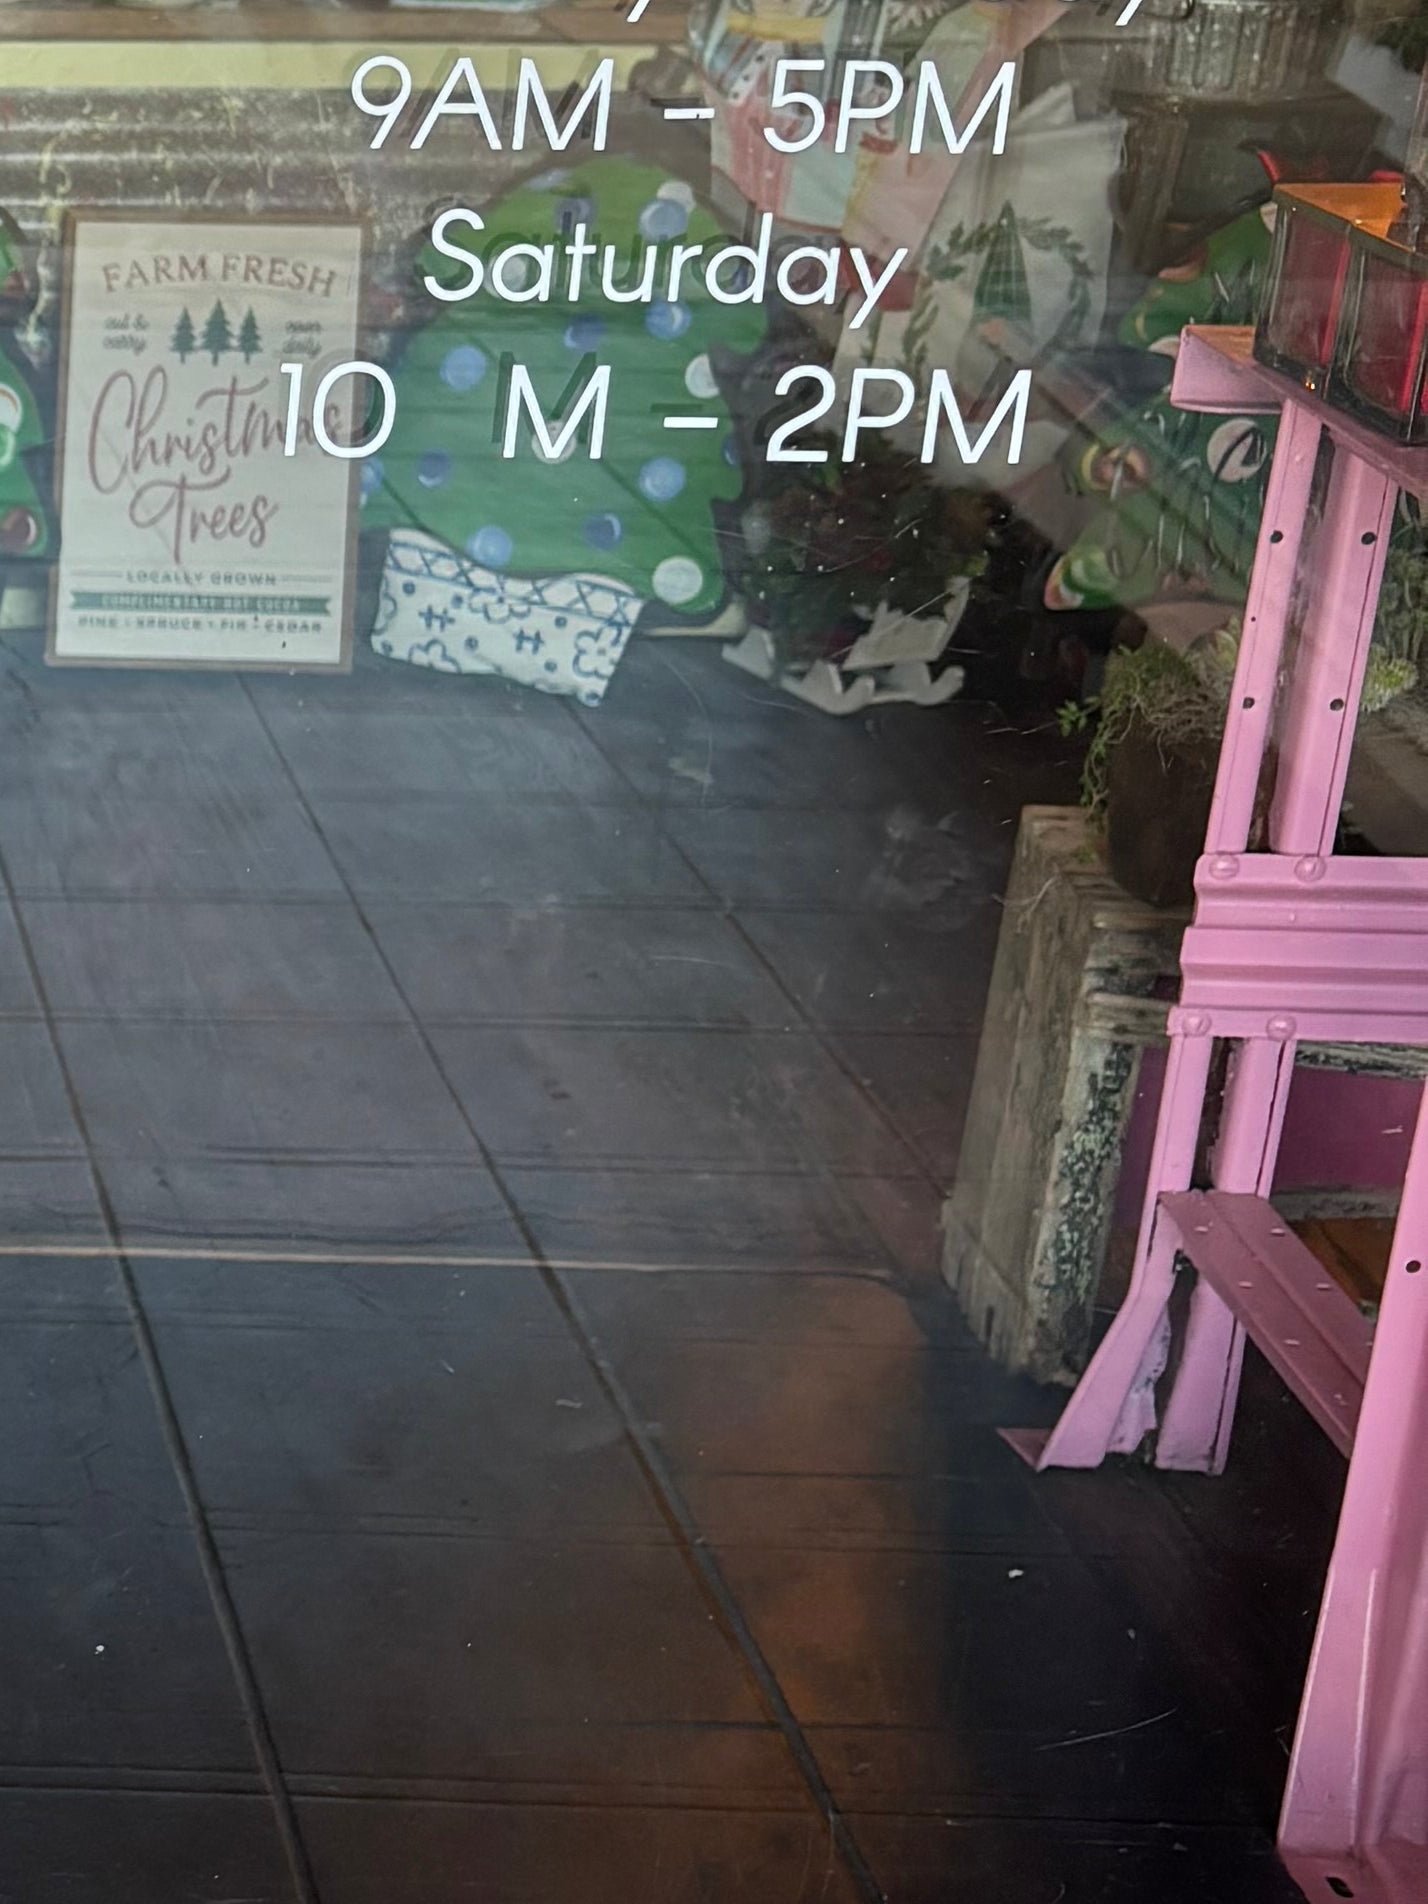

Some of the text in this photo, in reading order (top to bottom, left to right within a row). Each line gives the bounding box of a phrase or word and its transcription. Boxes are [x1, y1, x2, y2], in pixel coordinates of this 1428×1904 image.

[351, 55, 614, 151] 9AM
[763, 59, 1016, 155] 5PM
[101, 253, 338, 297] FARM FRESH
[424, 208, 908, 329] Saturday
[280, 361, 396, 458] 10
[766, 365, 1032, 464] 2PM
[129, 465, 280, 565] Trees
[126, 571, 278, 587] LOCALLY GROWN
